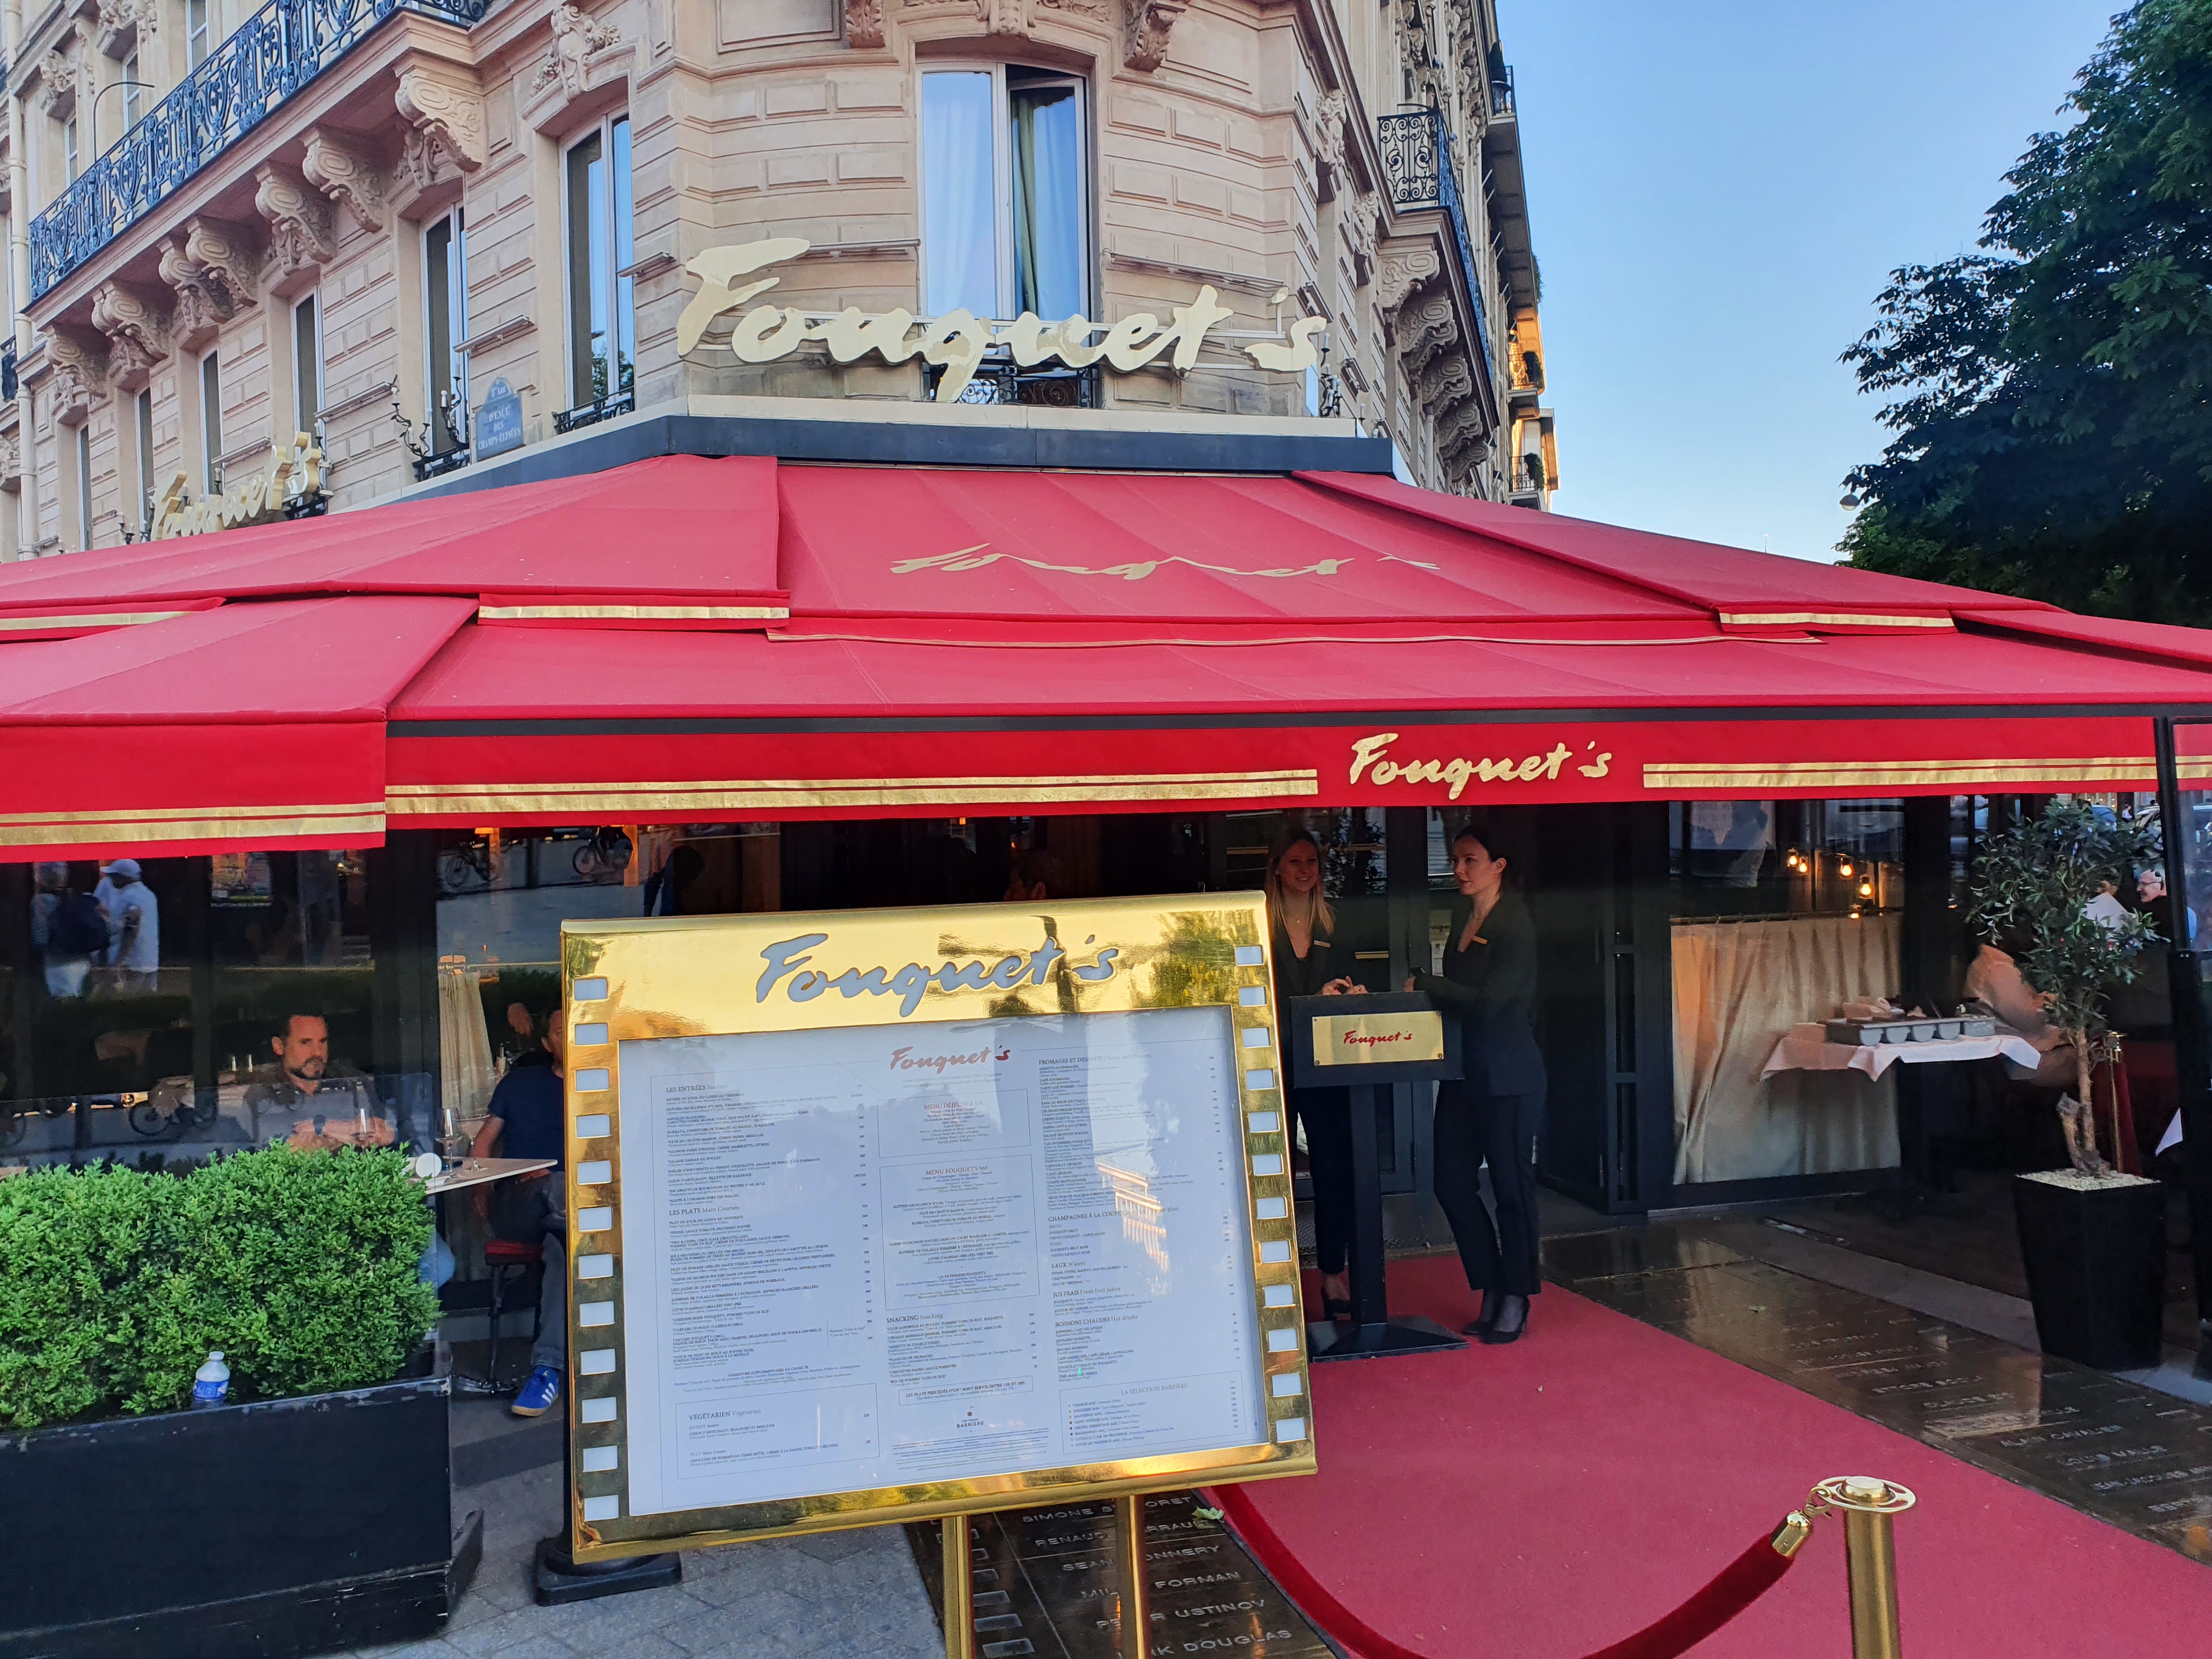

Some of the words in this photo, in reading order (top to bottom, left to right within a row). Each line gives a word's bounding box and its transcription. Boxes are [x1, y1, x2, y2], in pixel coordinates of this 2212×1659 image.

[678, 237, 1327, 403] Fouquet's
[488, 407, 510, 421] AVENUE
[494, 421, 504, 431] DES
[1350, 733, 1612, 800] Fouquet's
[756, 933, 1119, 1017] Fouquet's
[1344, 1030, 1413, 1047] Fouquet's
[890, 1045, 1011, 1074] Fouquet's
[944, 1100, 973, 1108] DÉJEUNER
[1129, 1385, 1160, 1393] SÉLECTION
[1161, 1382, 1187, 1390] BARRIÈRE
[689, 1410, 730, 1420] VÉGÉTARIEN
[732, 1408, 761, 1417] Vegetarian
[1023, 1508, 1094, 1522] SIMONE
[1035, 1532, 1107, 1547] RENAUD
[1063, 1559, 1114, 1571] SEAN
[1155, 1572, 1240, 1589] FORMAN
[1175, 1599, 1265, 1618] USTINOV
[1183, 1629, 1293, 1653] DOUGLAS
